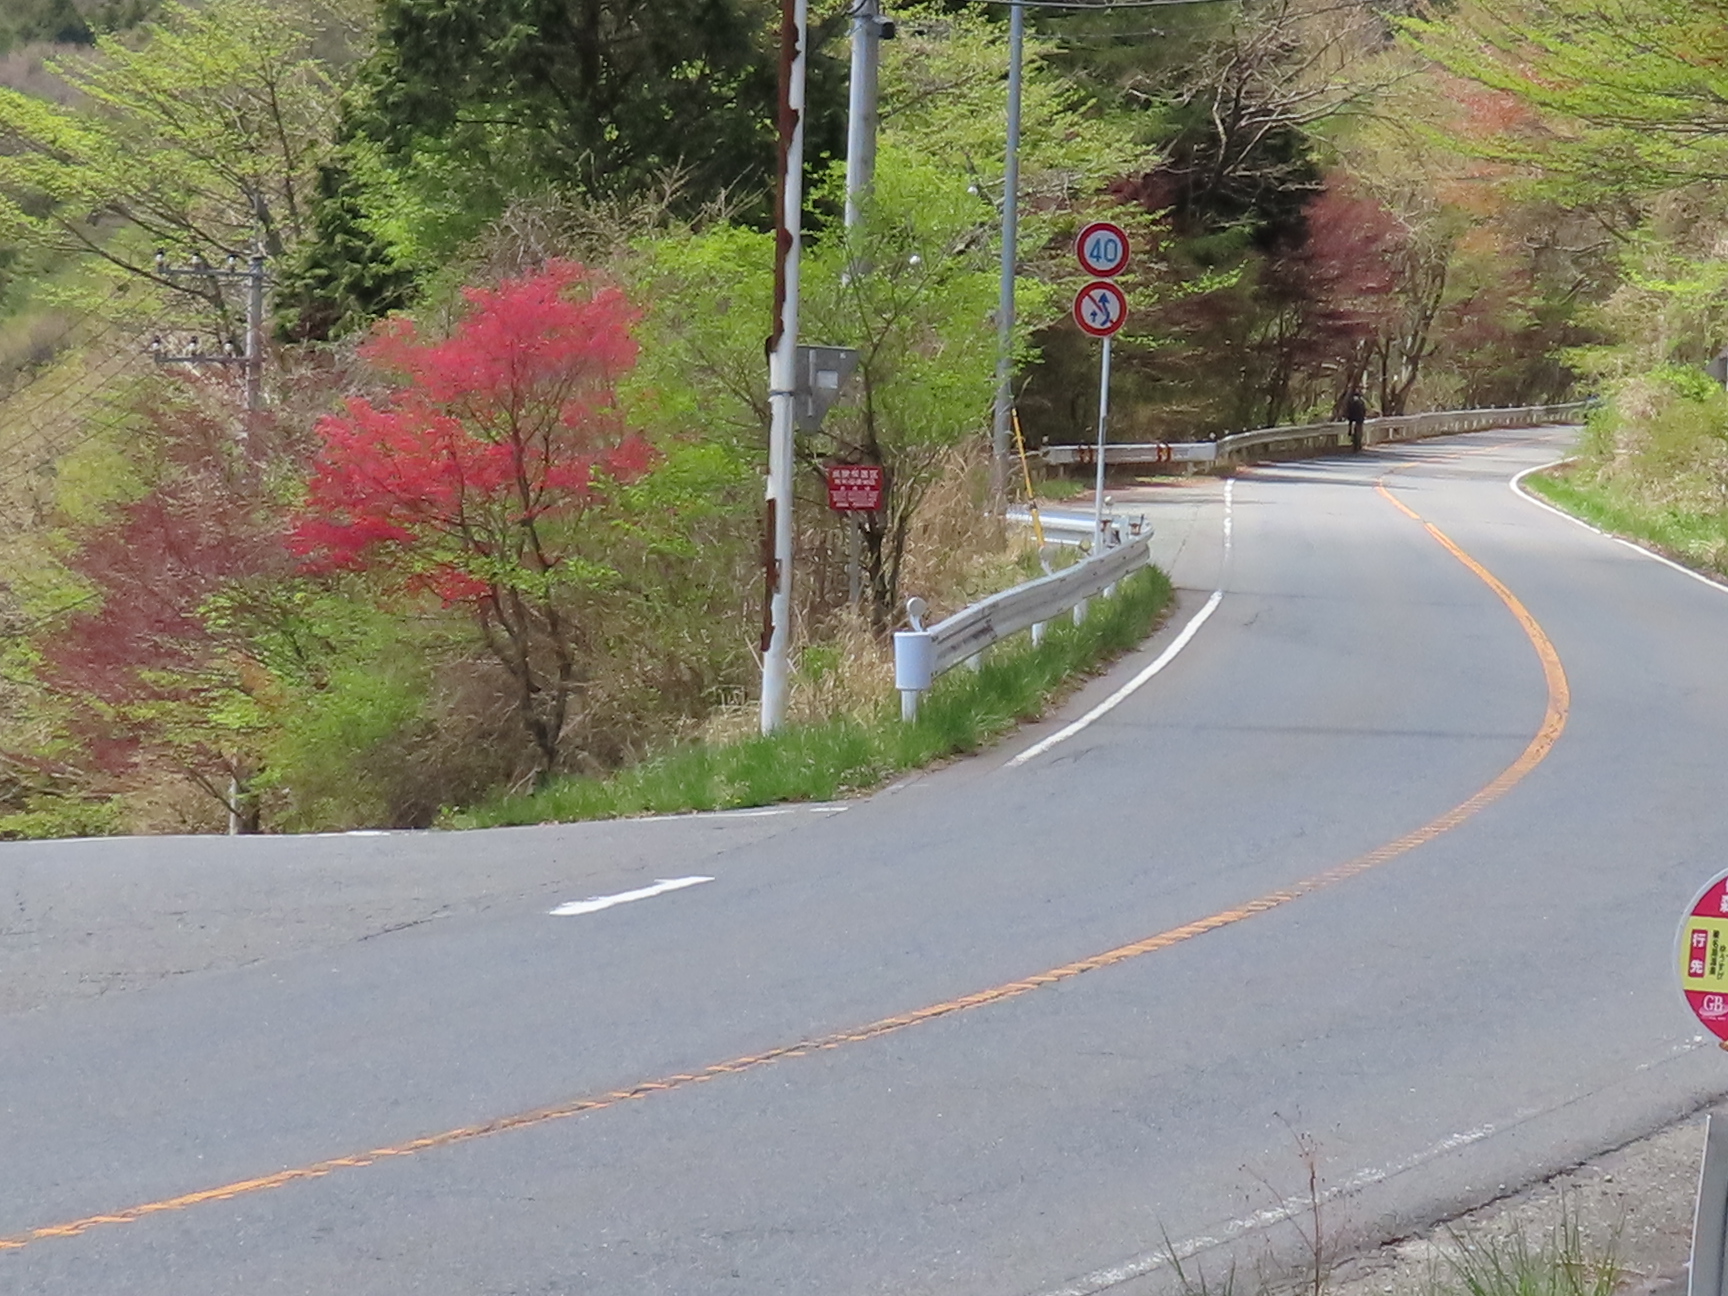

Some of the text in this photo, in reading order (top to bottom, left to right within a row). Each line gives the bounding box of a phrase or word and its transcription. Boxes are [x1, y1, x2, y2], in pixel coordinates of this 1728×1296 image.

[1089, 238, 1118, 263] 40
[1689, 932, 1707, 975] 行先
[1703, 994, 1724, 1012] GB
